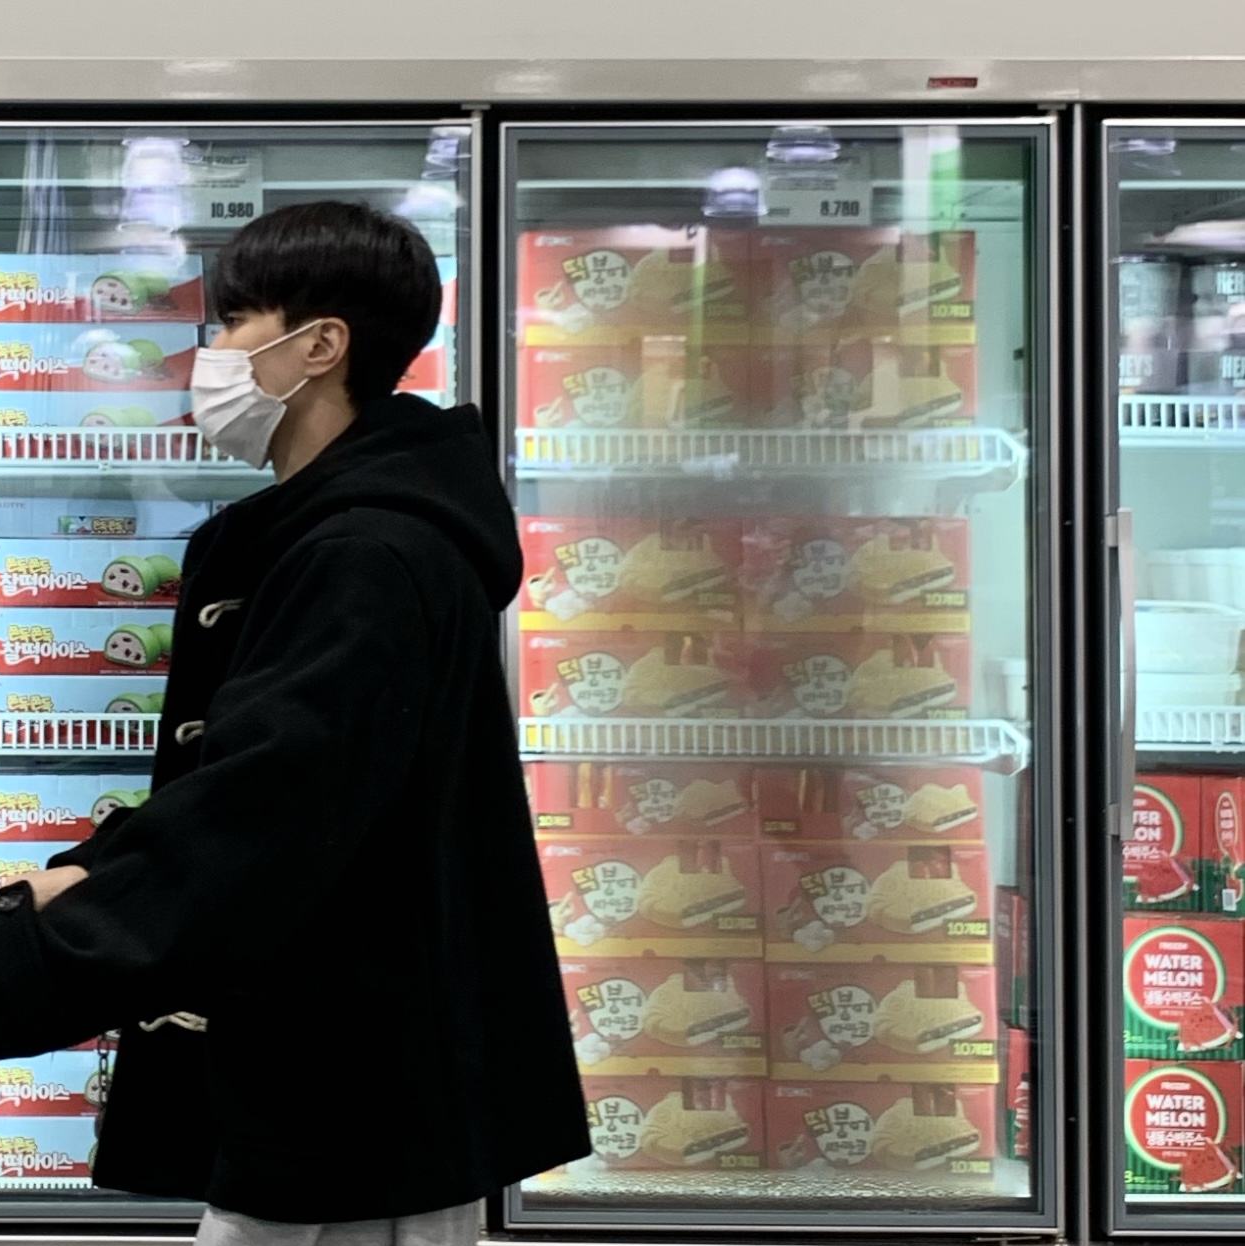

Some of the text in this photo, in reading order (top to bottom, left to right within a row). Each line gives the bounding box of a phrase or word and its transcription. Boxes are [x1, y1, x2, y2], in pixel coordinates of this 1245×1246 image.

[211, 202, 254, 219] 10,980
[0, 640, 90, 665] 찰떡아이스
[1133, 810, 1161, 825] TER
[1143, 954, 1203, 970] WATER
[1143, 971, 1204, 987] MELON
[1145, 1094, 1205, 1110] WATER
[1145, 1111, 1206, 1127] MELON
